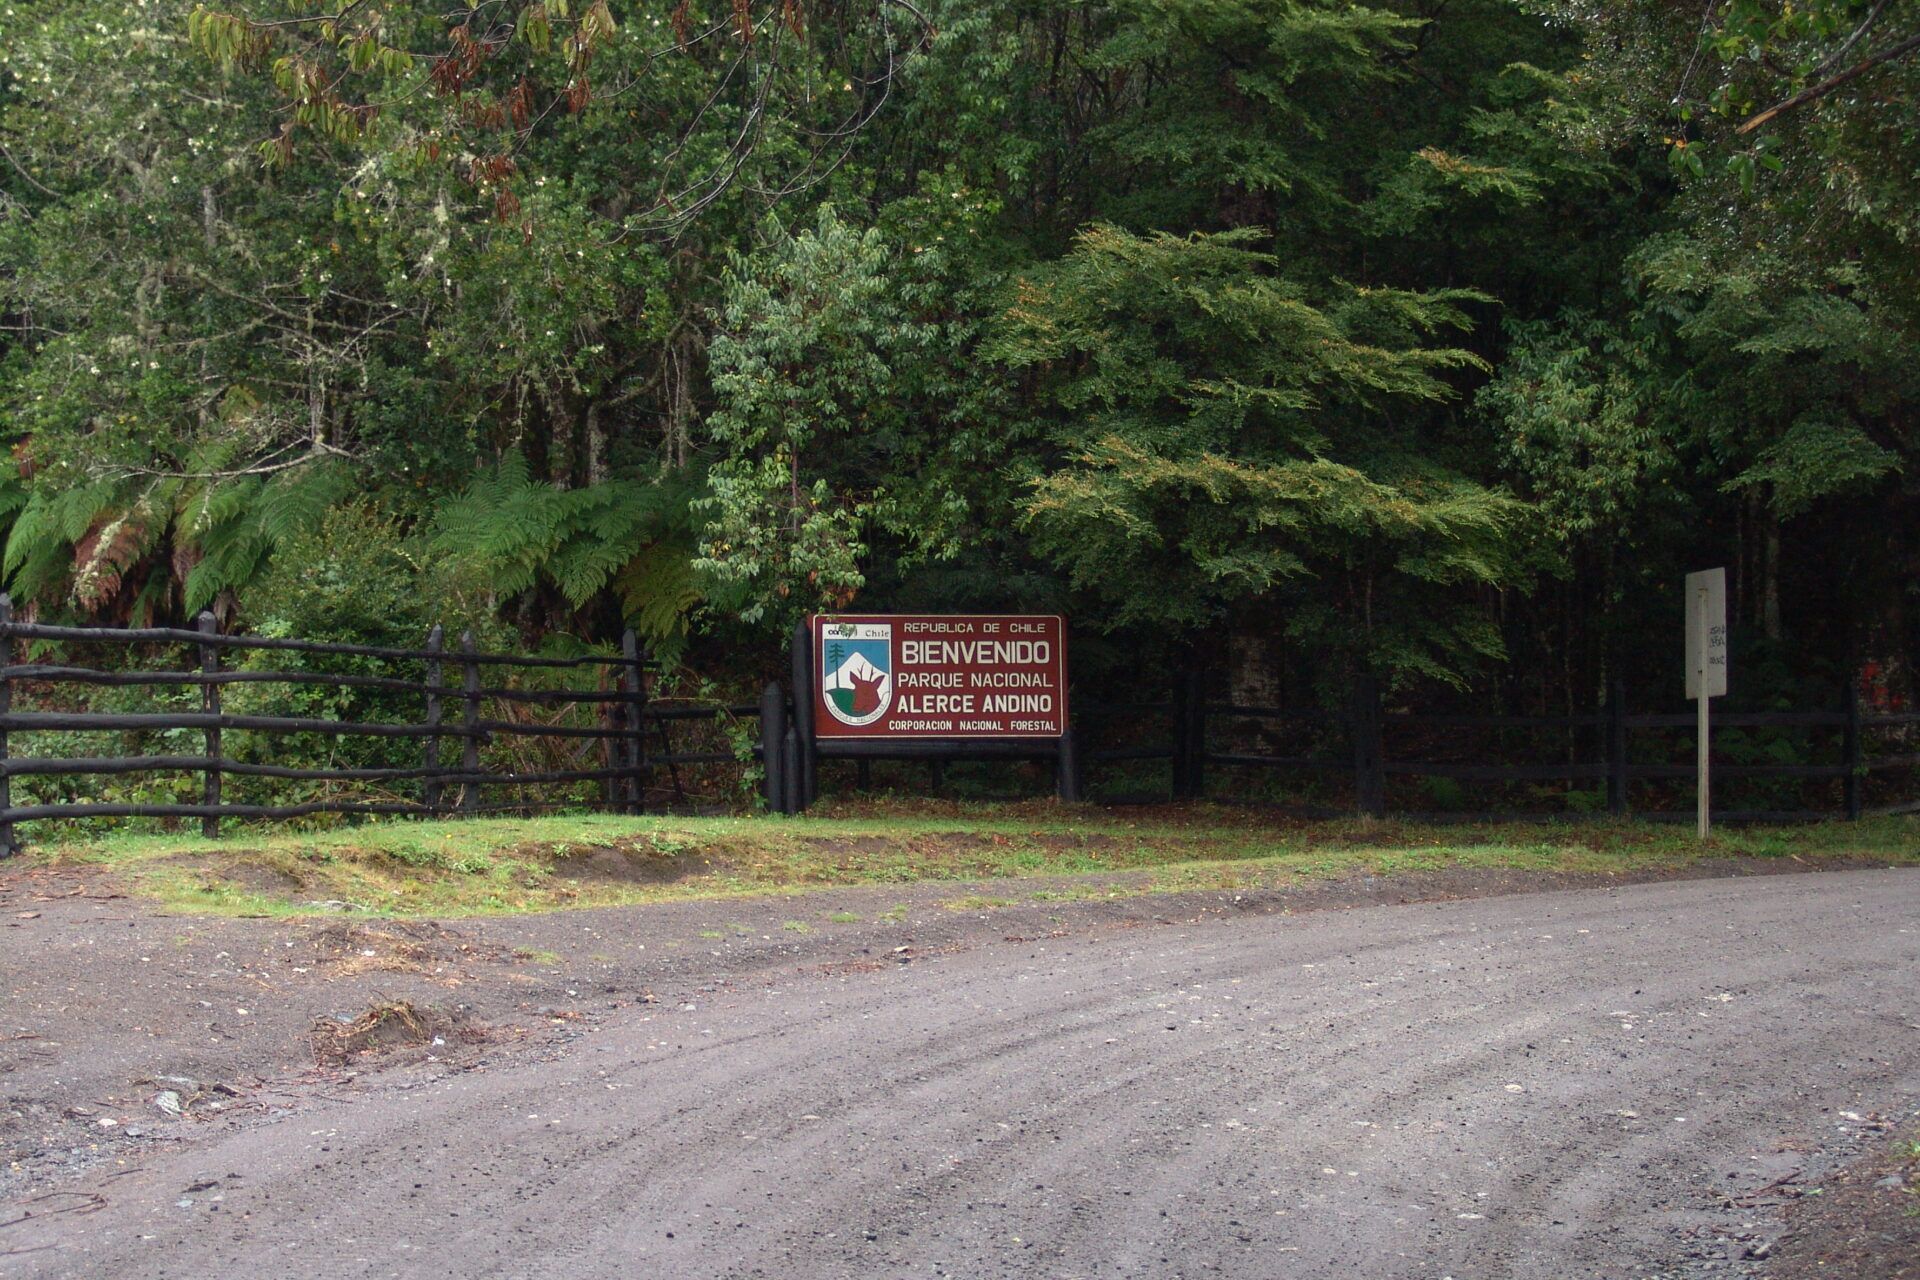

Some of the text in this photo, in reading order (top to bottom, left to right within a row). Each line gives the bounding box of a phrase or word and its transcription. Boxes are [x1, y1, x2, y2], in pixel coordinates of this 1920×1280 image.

[904, 623, 1046, 633] REPUBLICA DE CHILE
[902, 641, 1050, 664] BIENVENIDO
[898, 673, 1054, 689] PARQUE NACIONAL
[897, 694, 1052, 713] ALERCE ANDINO
[889, 720, 1057, 731] CORPORACION NACIONAL FORESTAL
